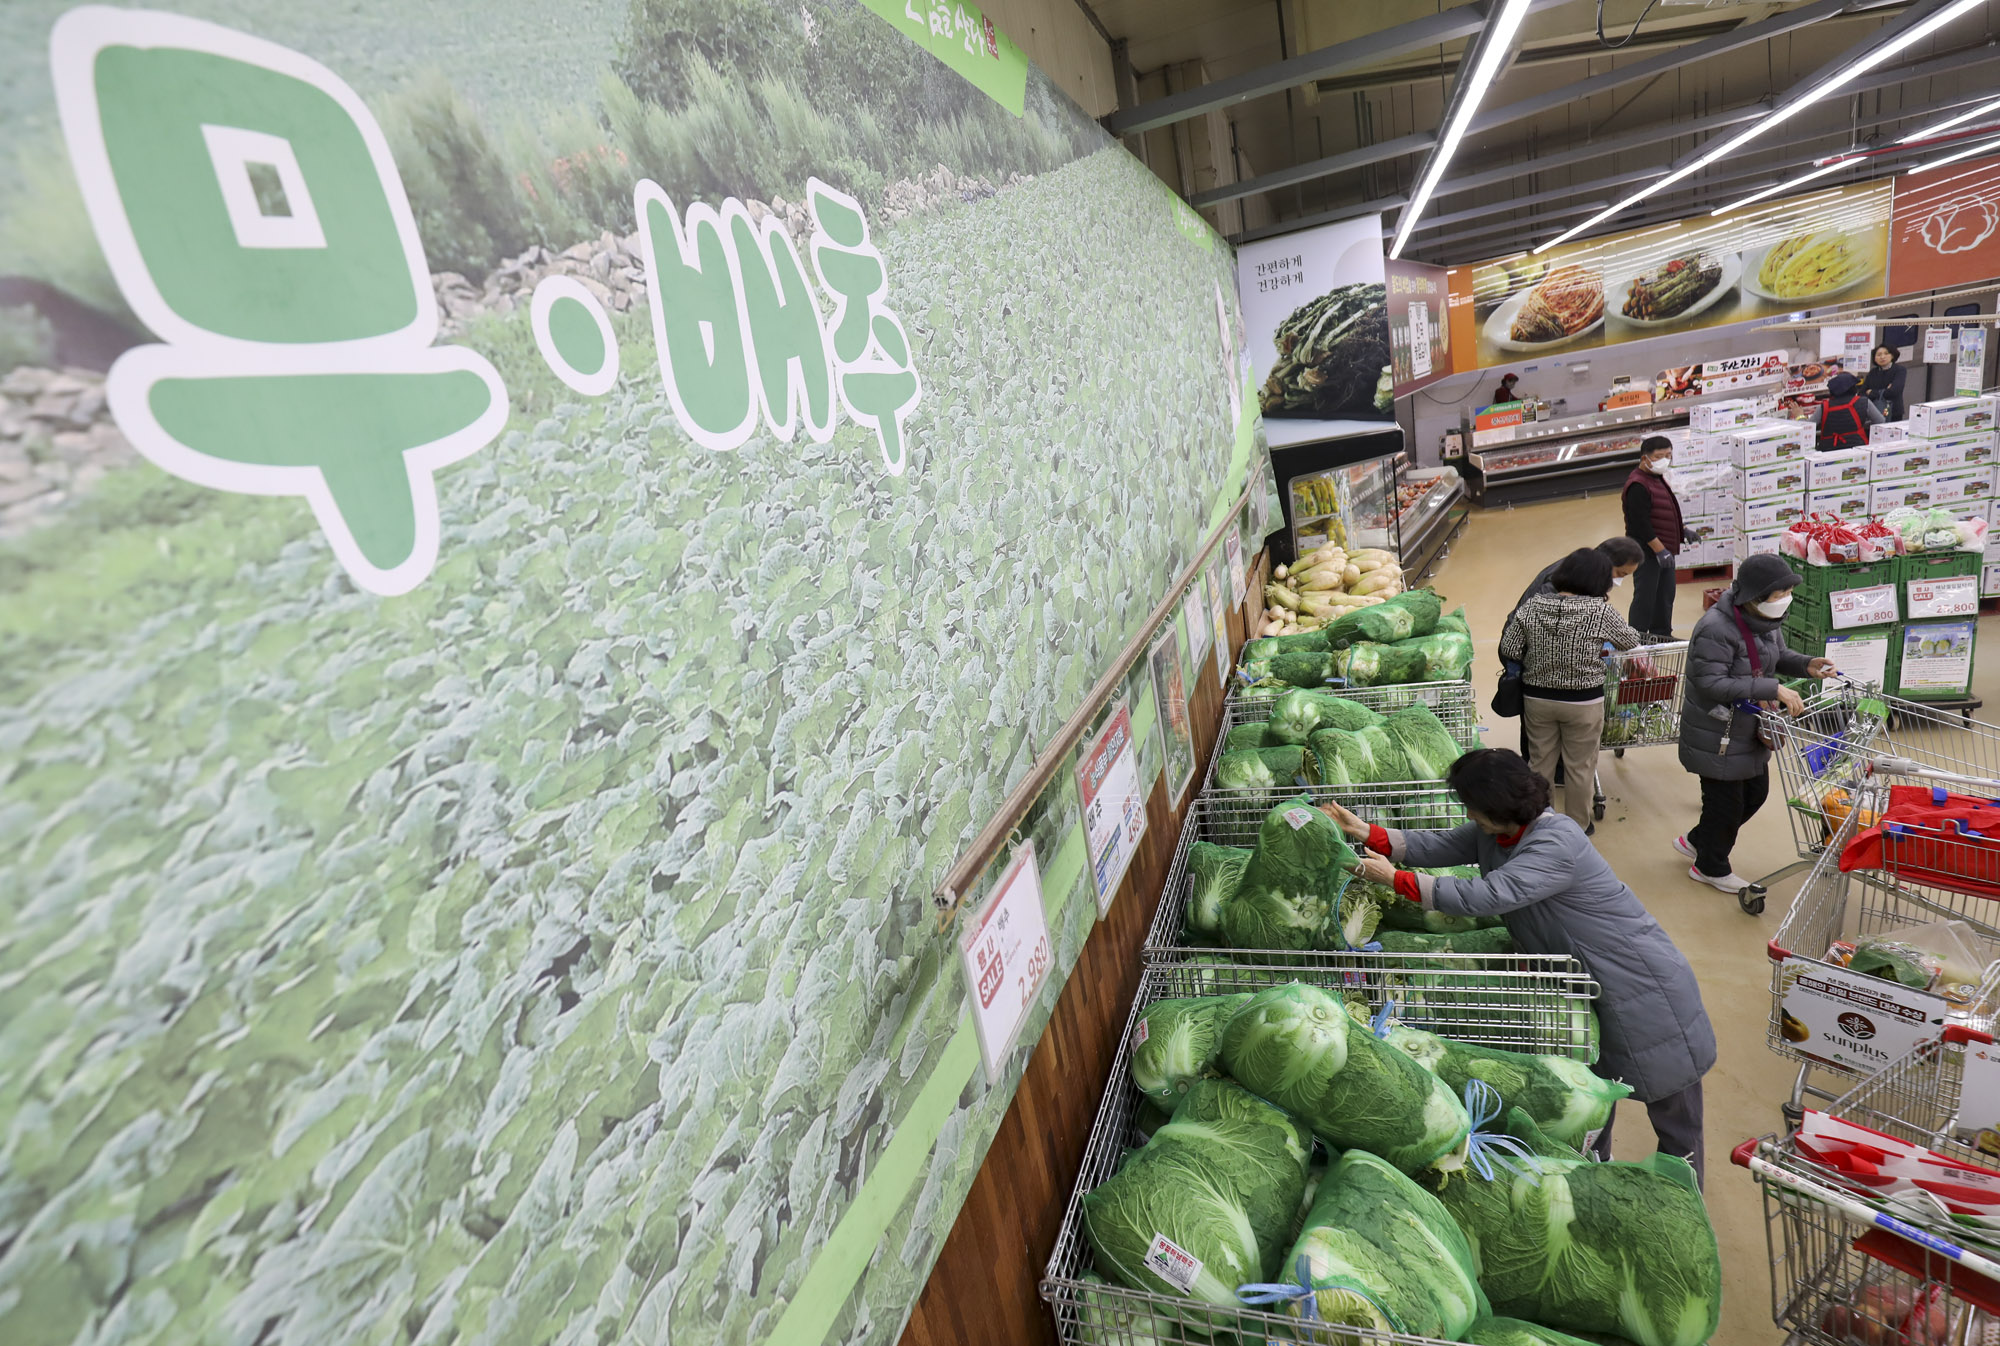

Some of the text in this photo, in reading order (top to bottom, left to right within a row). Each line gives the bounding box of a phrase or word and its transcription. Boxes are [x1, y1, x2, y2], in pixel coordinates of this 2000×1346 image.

[1254, 254, 1303, 277] 간편하게
[1256, 271, 1305, 293] 건강하게
[1857, 610, 1894, 623] 41,800
[977, 935, 995, 972] 행사
[981, 956, 1003, 1003] SALE
[1018, 935, 1047, 1008] 2,980
[1852, 983, 1879, 997] 소비자가
[1848, 991, 1878, 1006] 브랜드
[1879, 1000, 1901, 1014] 대상
[1901, 1007, 1925, 1021] 수상
[1823, 1032, 1889, 1060] sunplus
